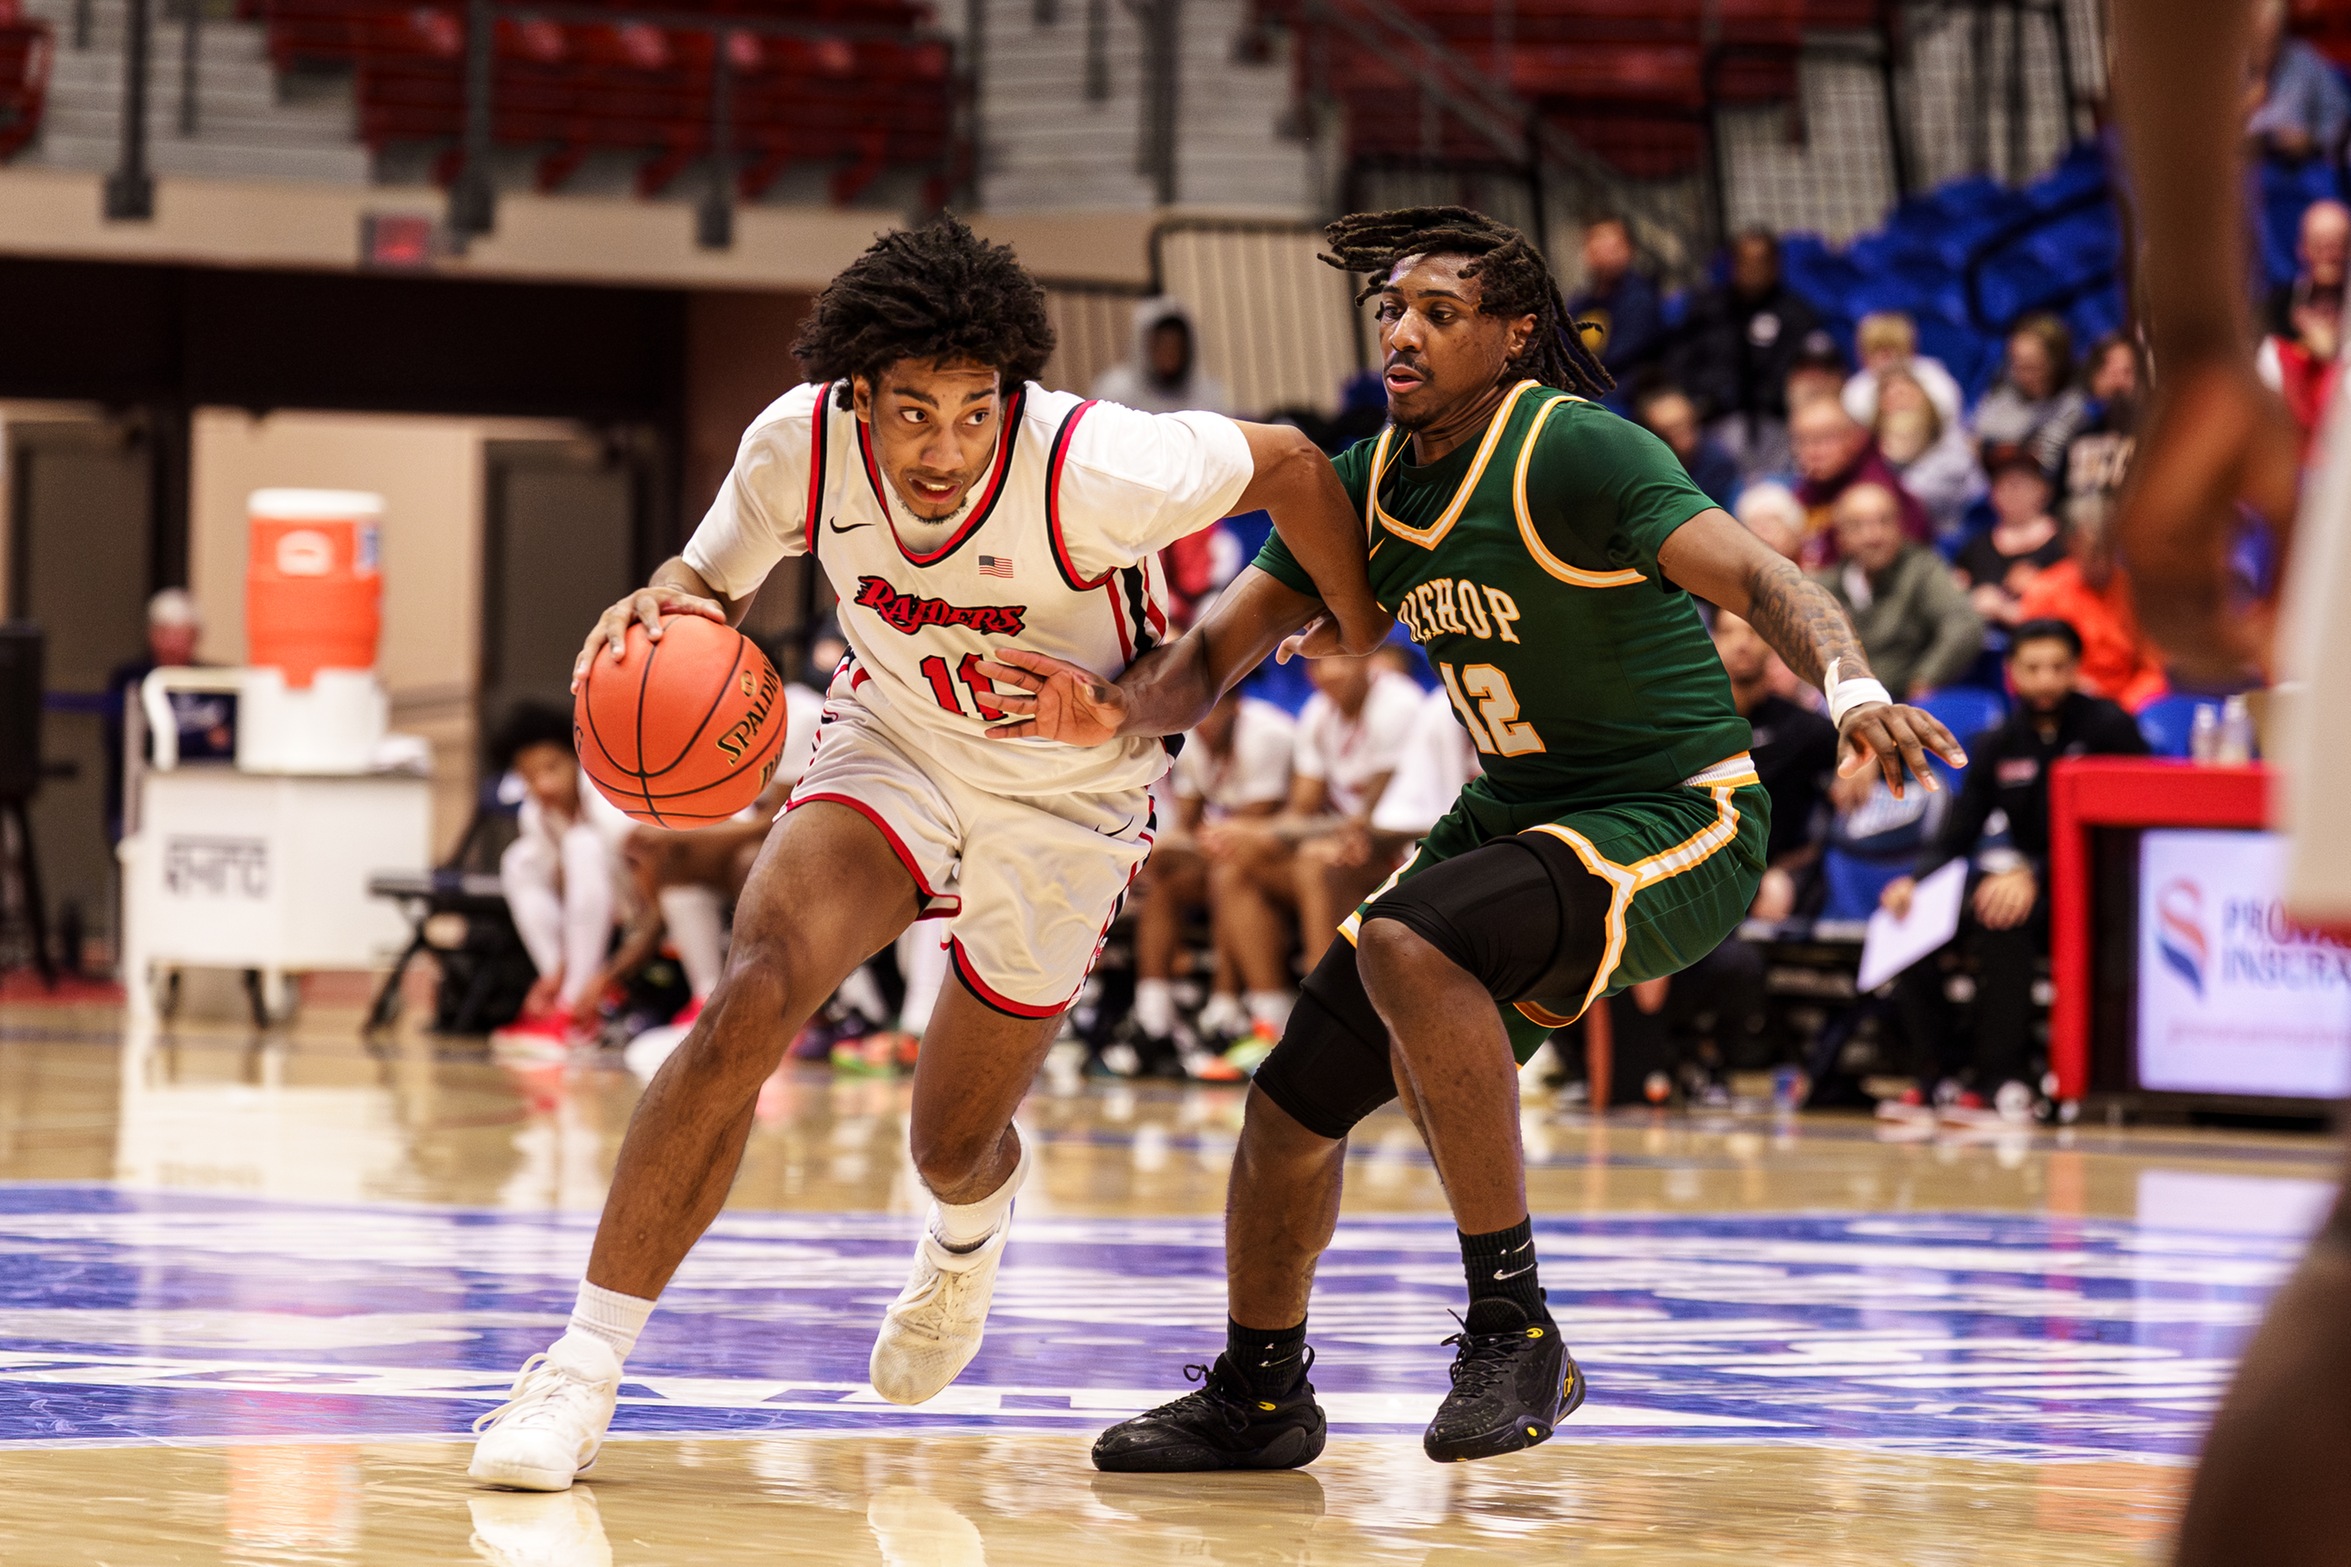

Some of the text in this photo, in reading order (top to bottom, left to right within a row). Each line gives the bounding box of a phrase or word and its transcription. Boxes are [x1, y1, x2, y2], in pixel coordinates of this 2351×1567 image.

[854, 575, 1027, 637] RAIDERS
[715, 652, 780, 767] SPALDIN
[919, 652, 1009, 722] 11
[1439, 661, 1547, 758] 12
